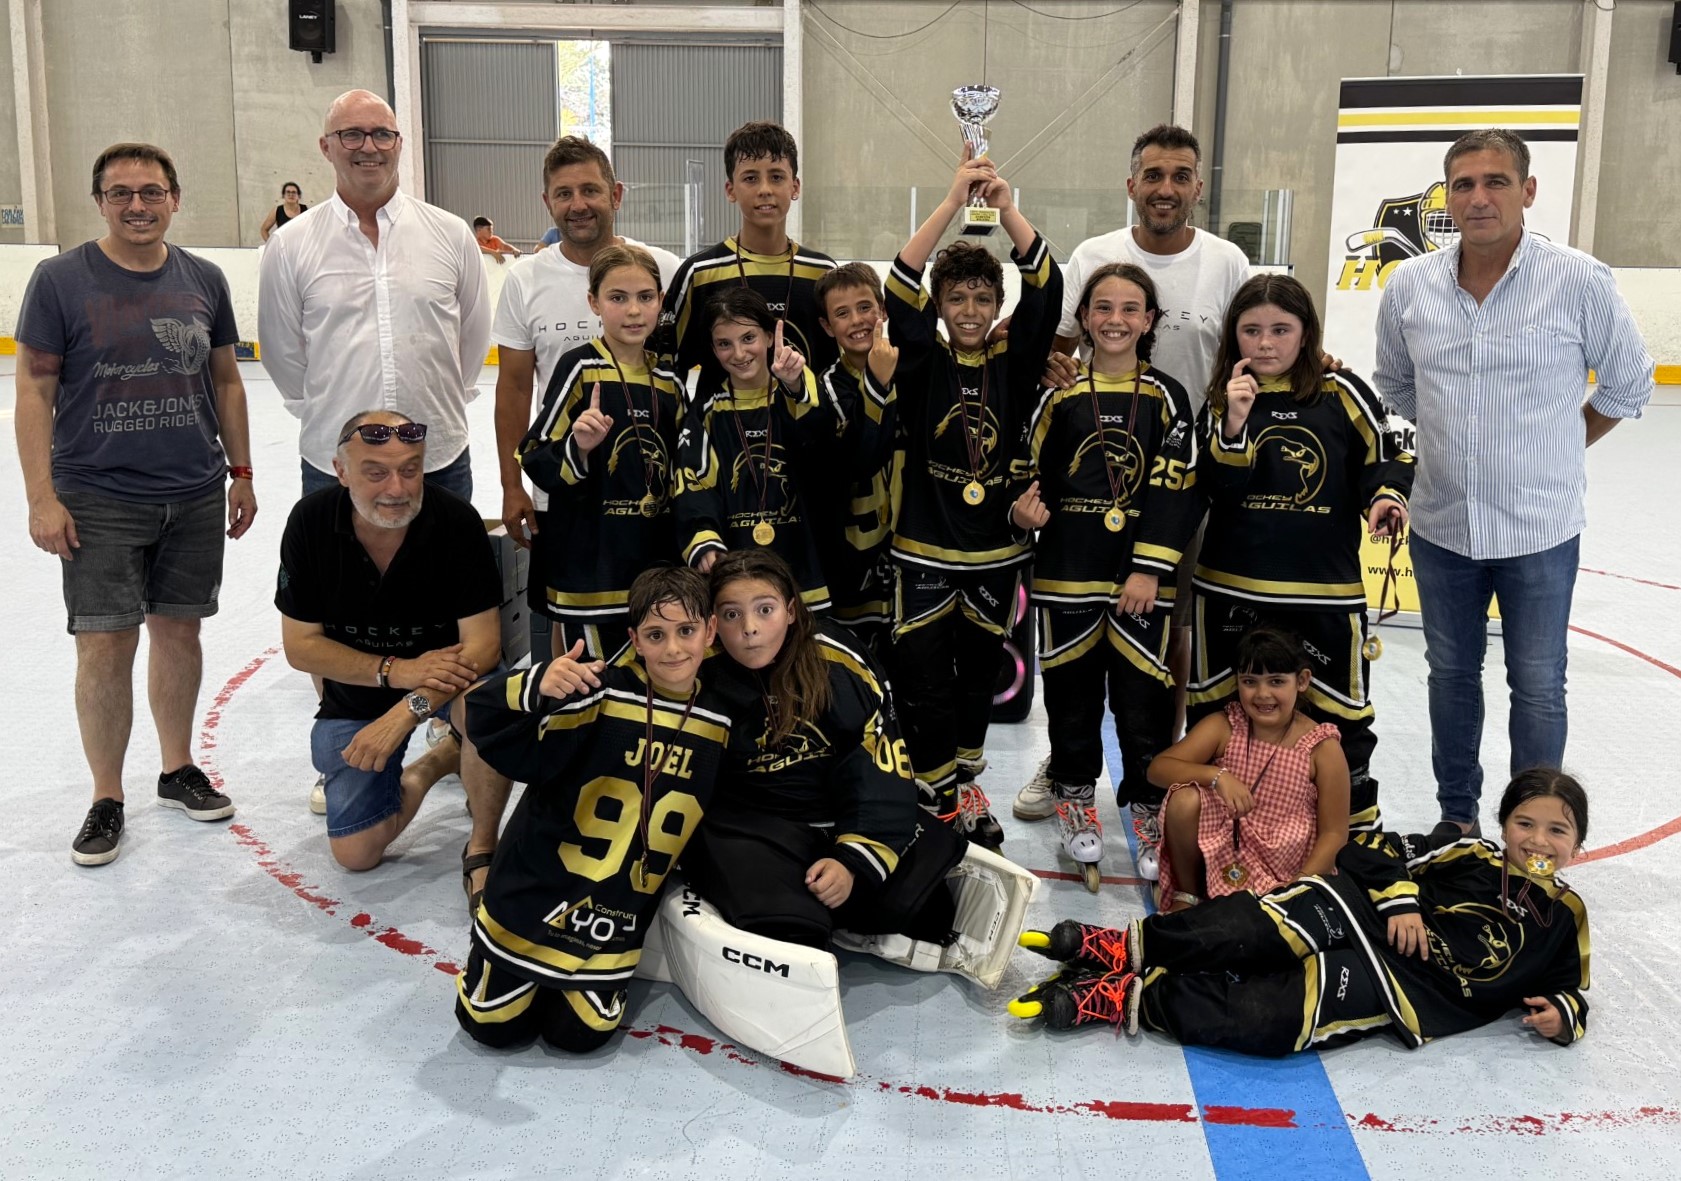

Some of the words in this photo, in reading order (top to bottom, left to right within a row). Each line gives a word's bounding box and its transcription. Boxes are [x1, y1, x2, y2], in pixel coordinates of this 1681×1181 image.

[94, 419, 155, 433] RUGGED
[1149, 455, 1186, 491] 25
[624, 738, 694, 780] JOEL
[557, 775, 704, 895] 99
[722, 946, 789, 978] CCM
